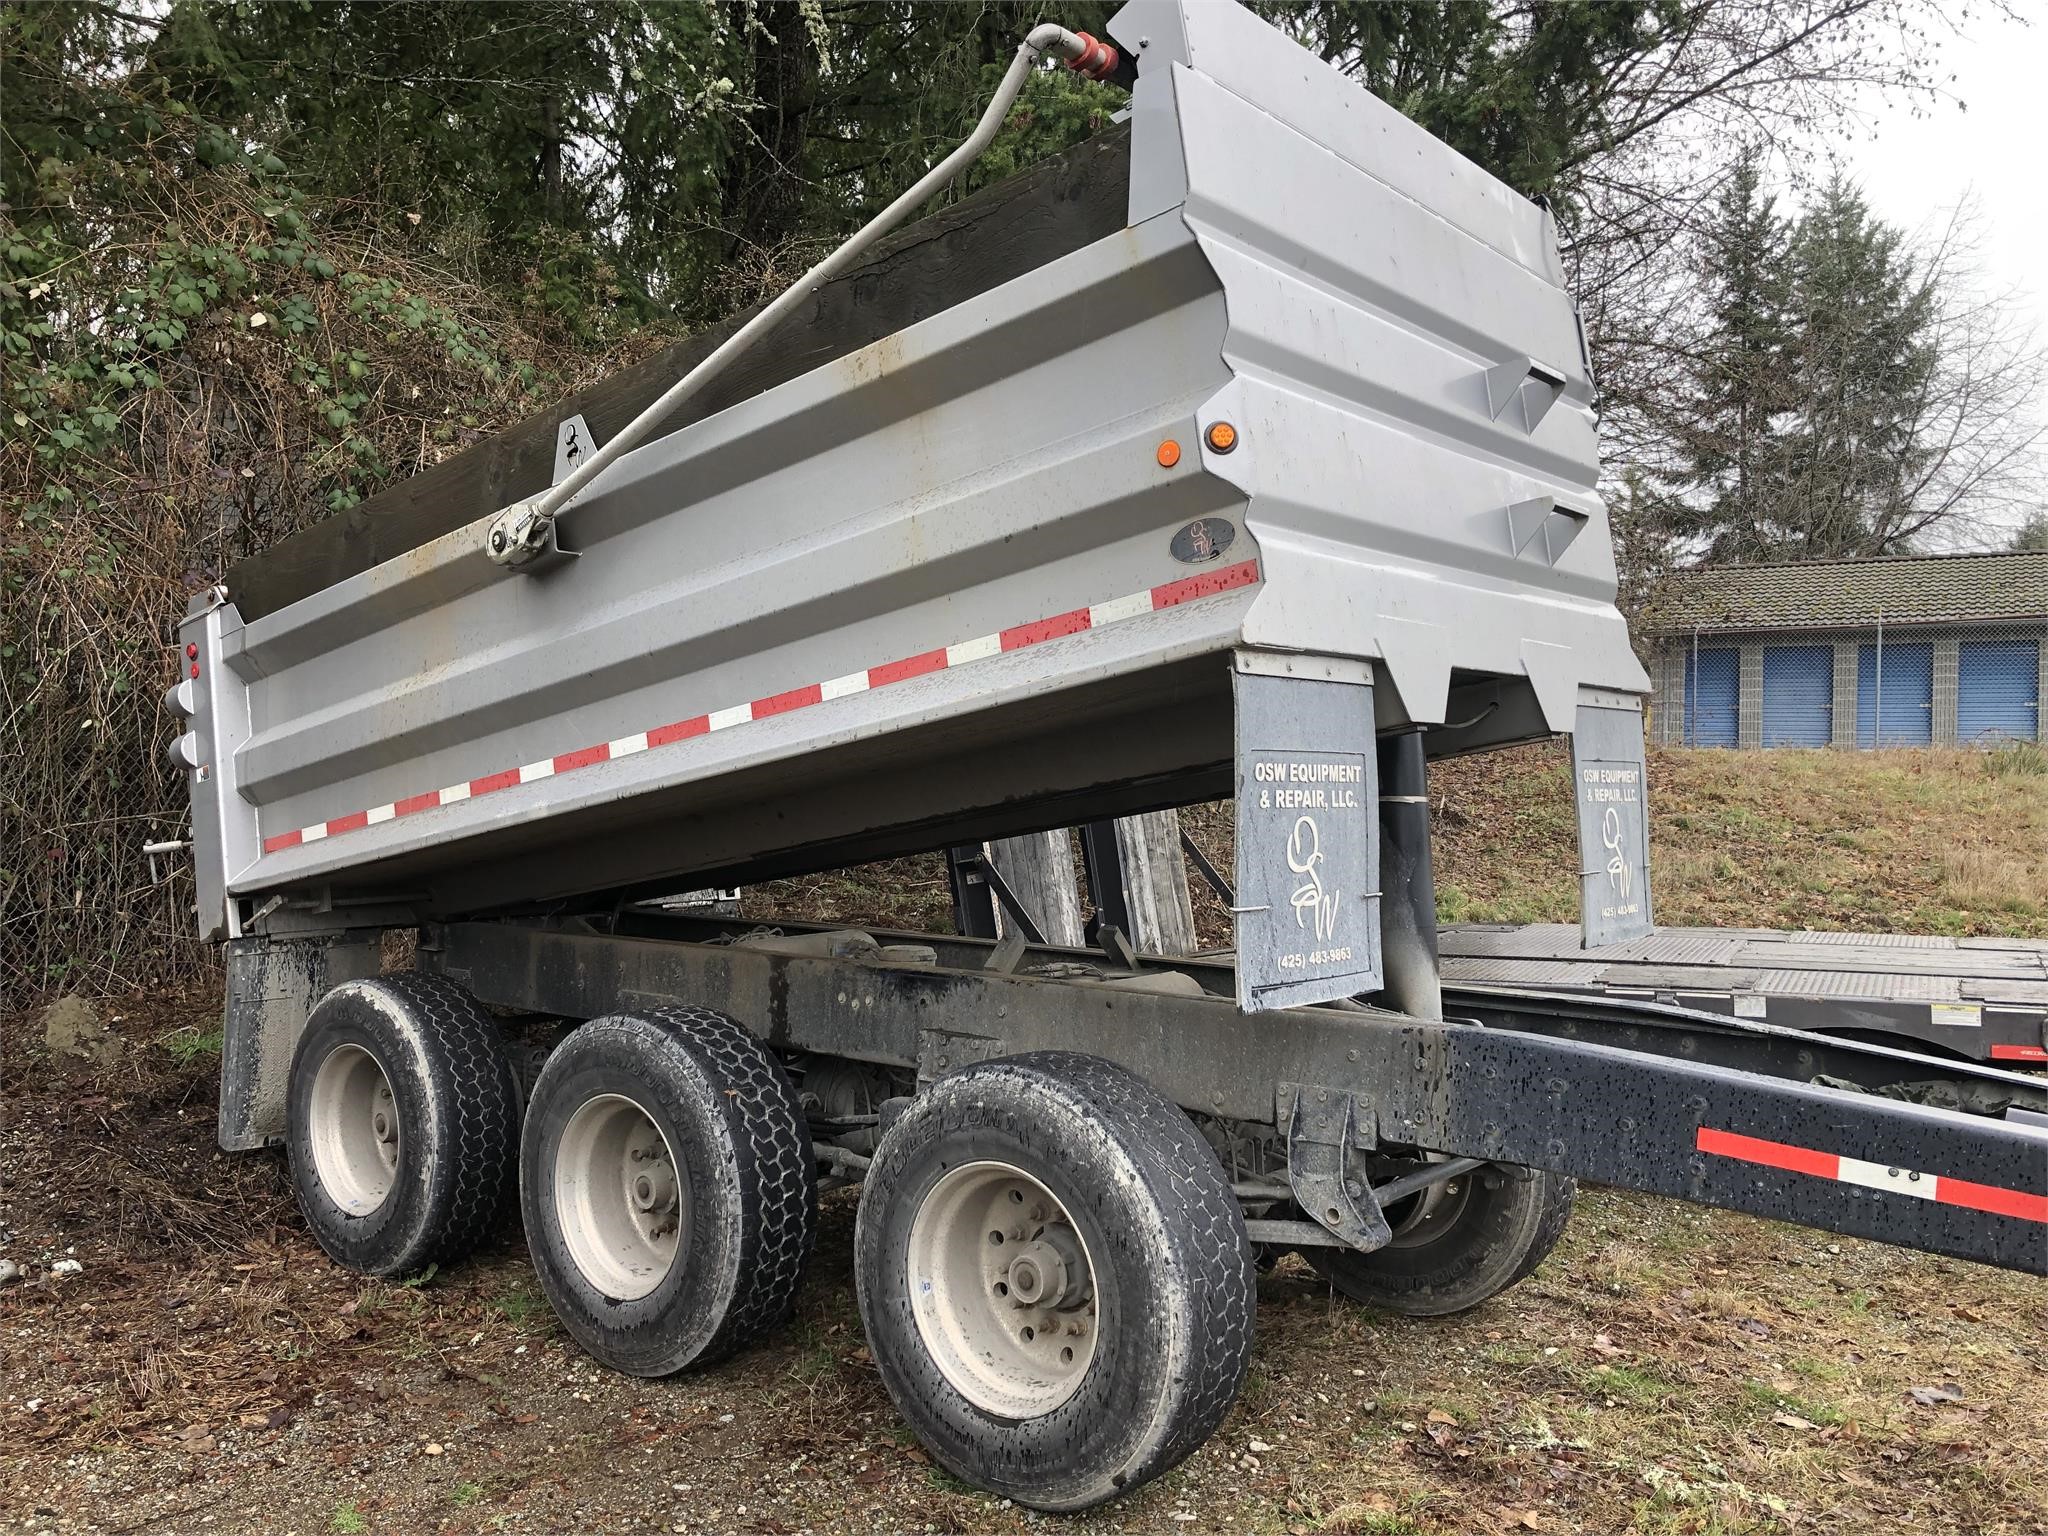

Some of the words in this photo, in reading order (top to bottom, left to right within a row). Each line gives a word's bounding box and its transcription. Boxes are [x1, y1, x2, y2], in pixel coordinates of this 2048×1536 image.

[1254, 762, 1286, 782] OSW
[1289, 763, 1361, 783] EQUIPMENT
[1583, 769, 1599, 783] OSW
[1600, 769, 1639, 784] EQUIPMENT
[1259, 789, 1270, 808] &
[1275, 789, 1328, 812] REPAIR,
[1331, 790, 1358, 808] LLC.
[1587, 788, 1592, 802] &
[1277, 953, 1306, 973] (425)
[1309, 946, 1352, 965] 483-9863
